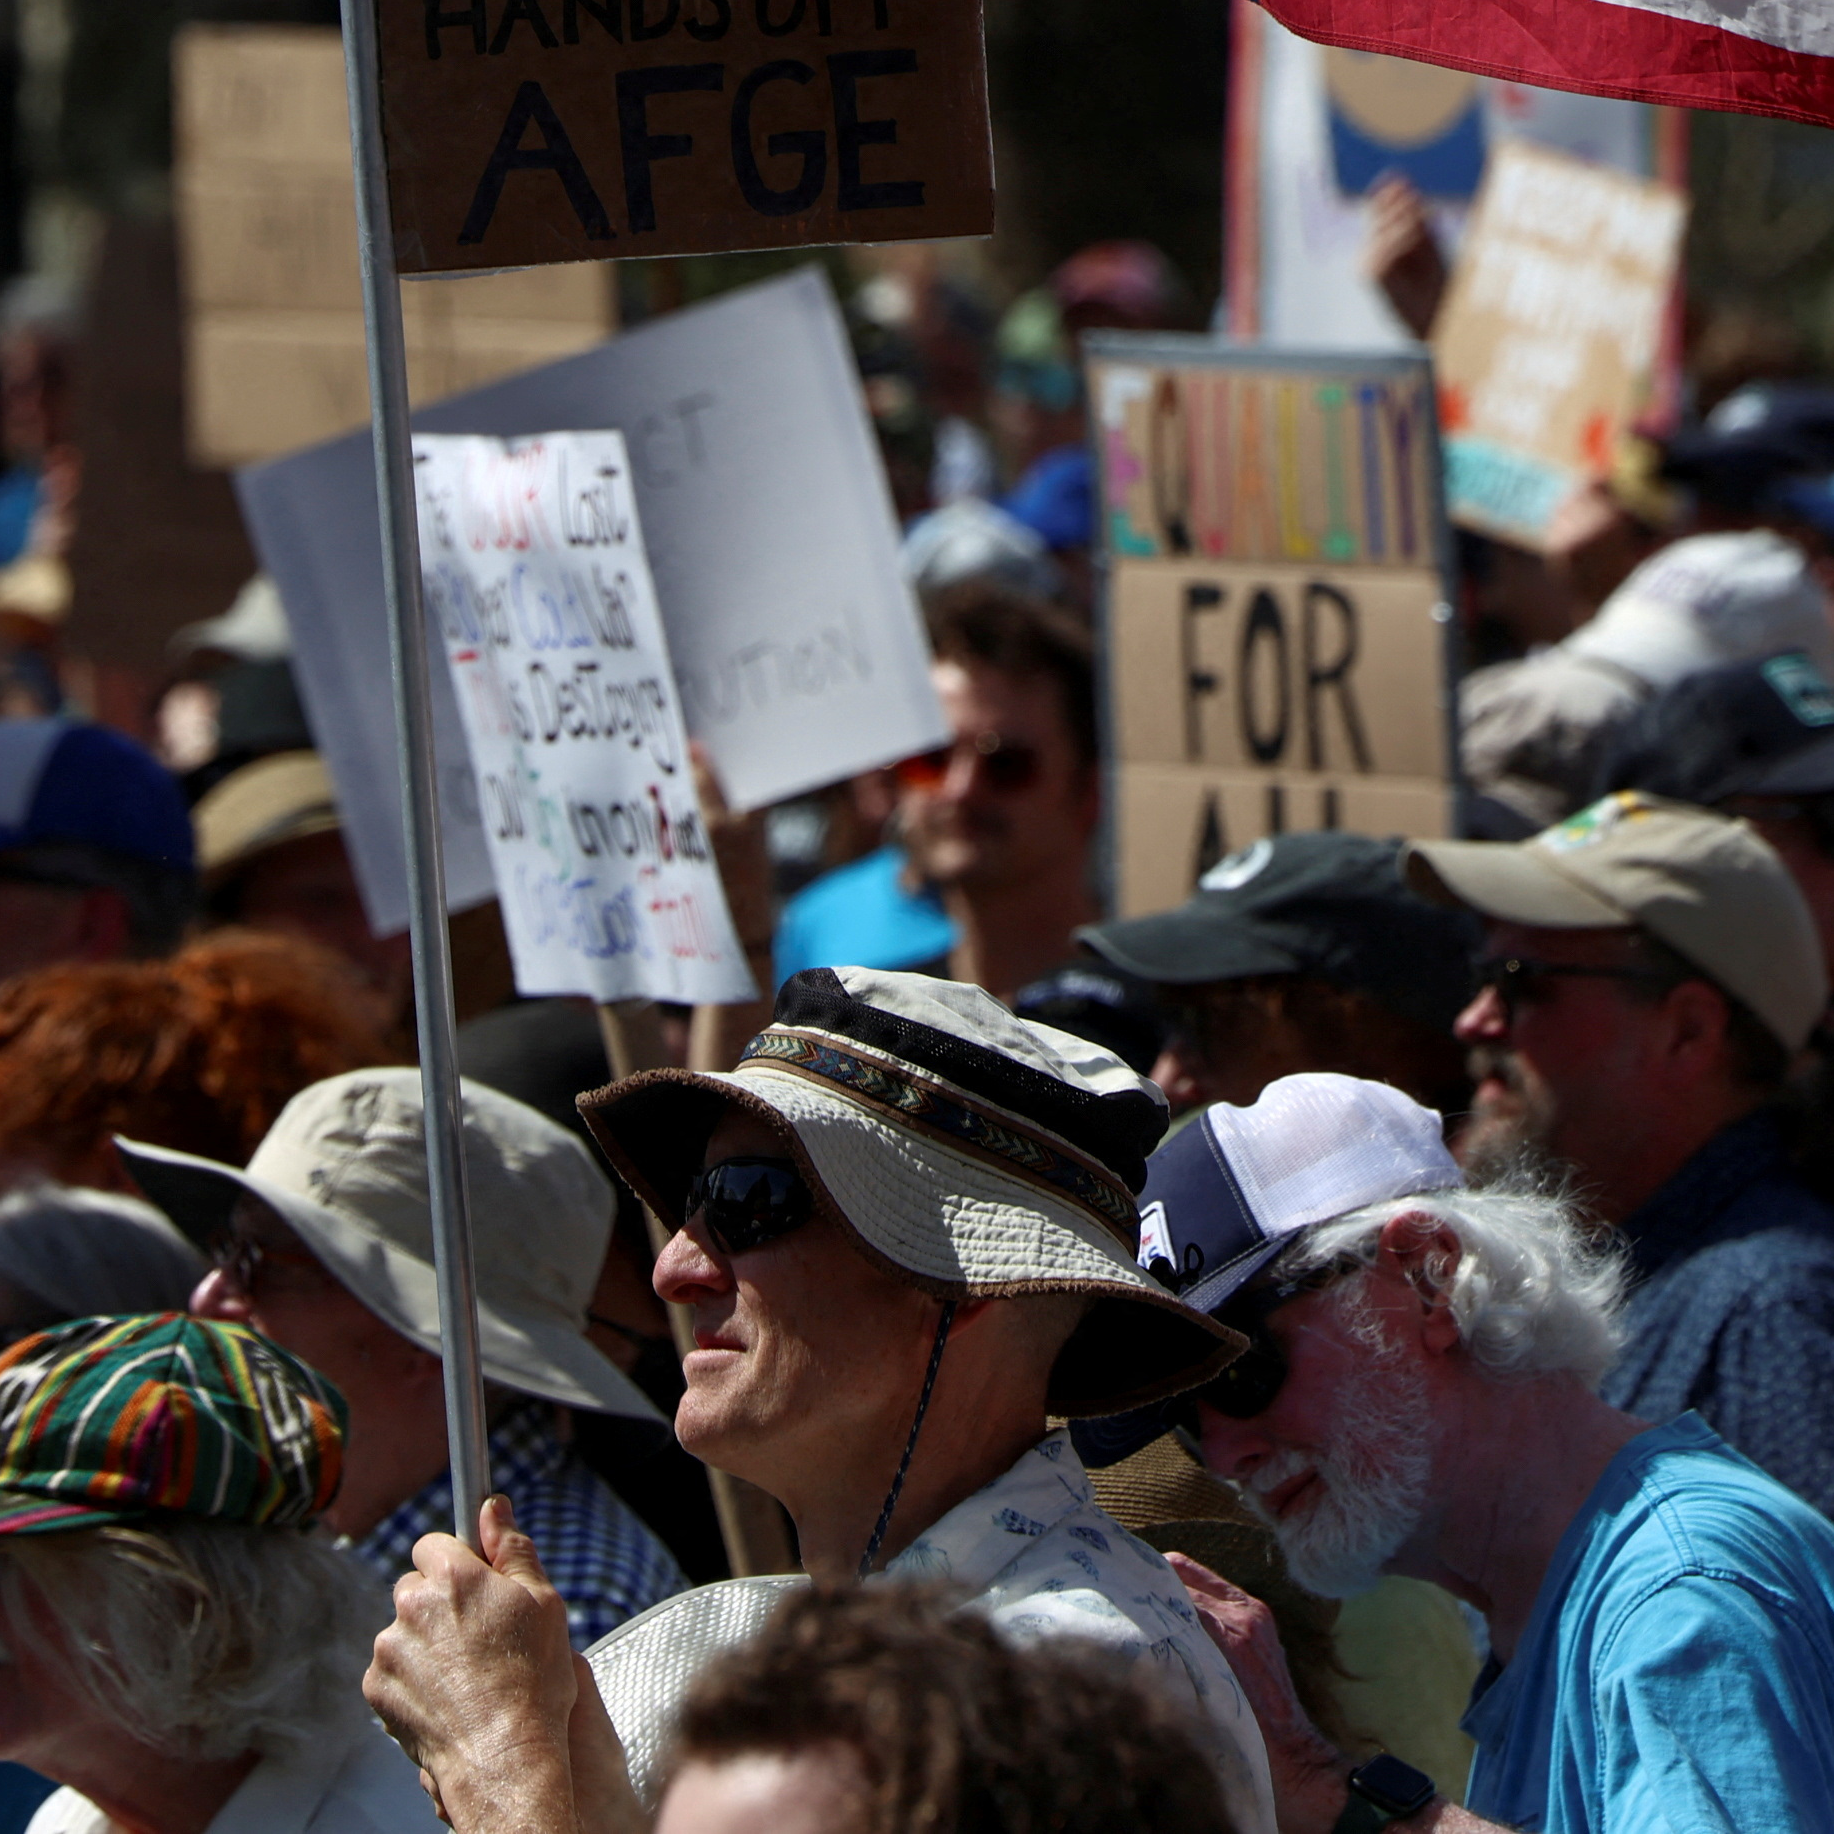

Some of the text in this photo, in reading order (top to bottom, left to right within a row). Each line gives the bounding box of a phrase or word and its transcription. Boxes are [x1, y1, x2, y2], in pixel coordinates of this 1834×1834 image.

[456, 48, 926, 245] AFGE
[1101, 368, 1429, 560] EQUALITY
[1179, 580, 1373, 774] FOR
